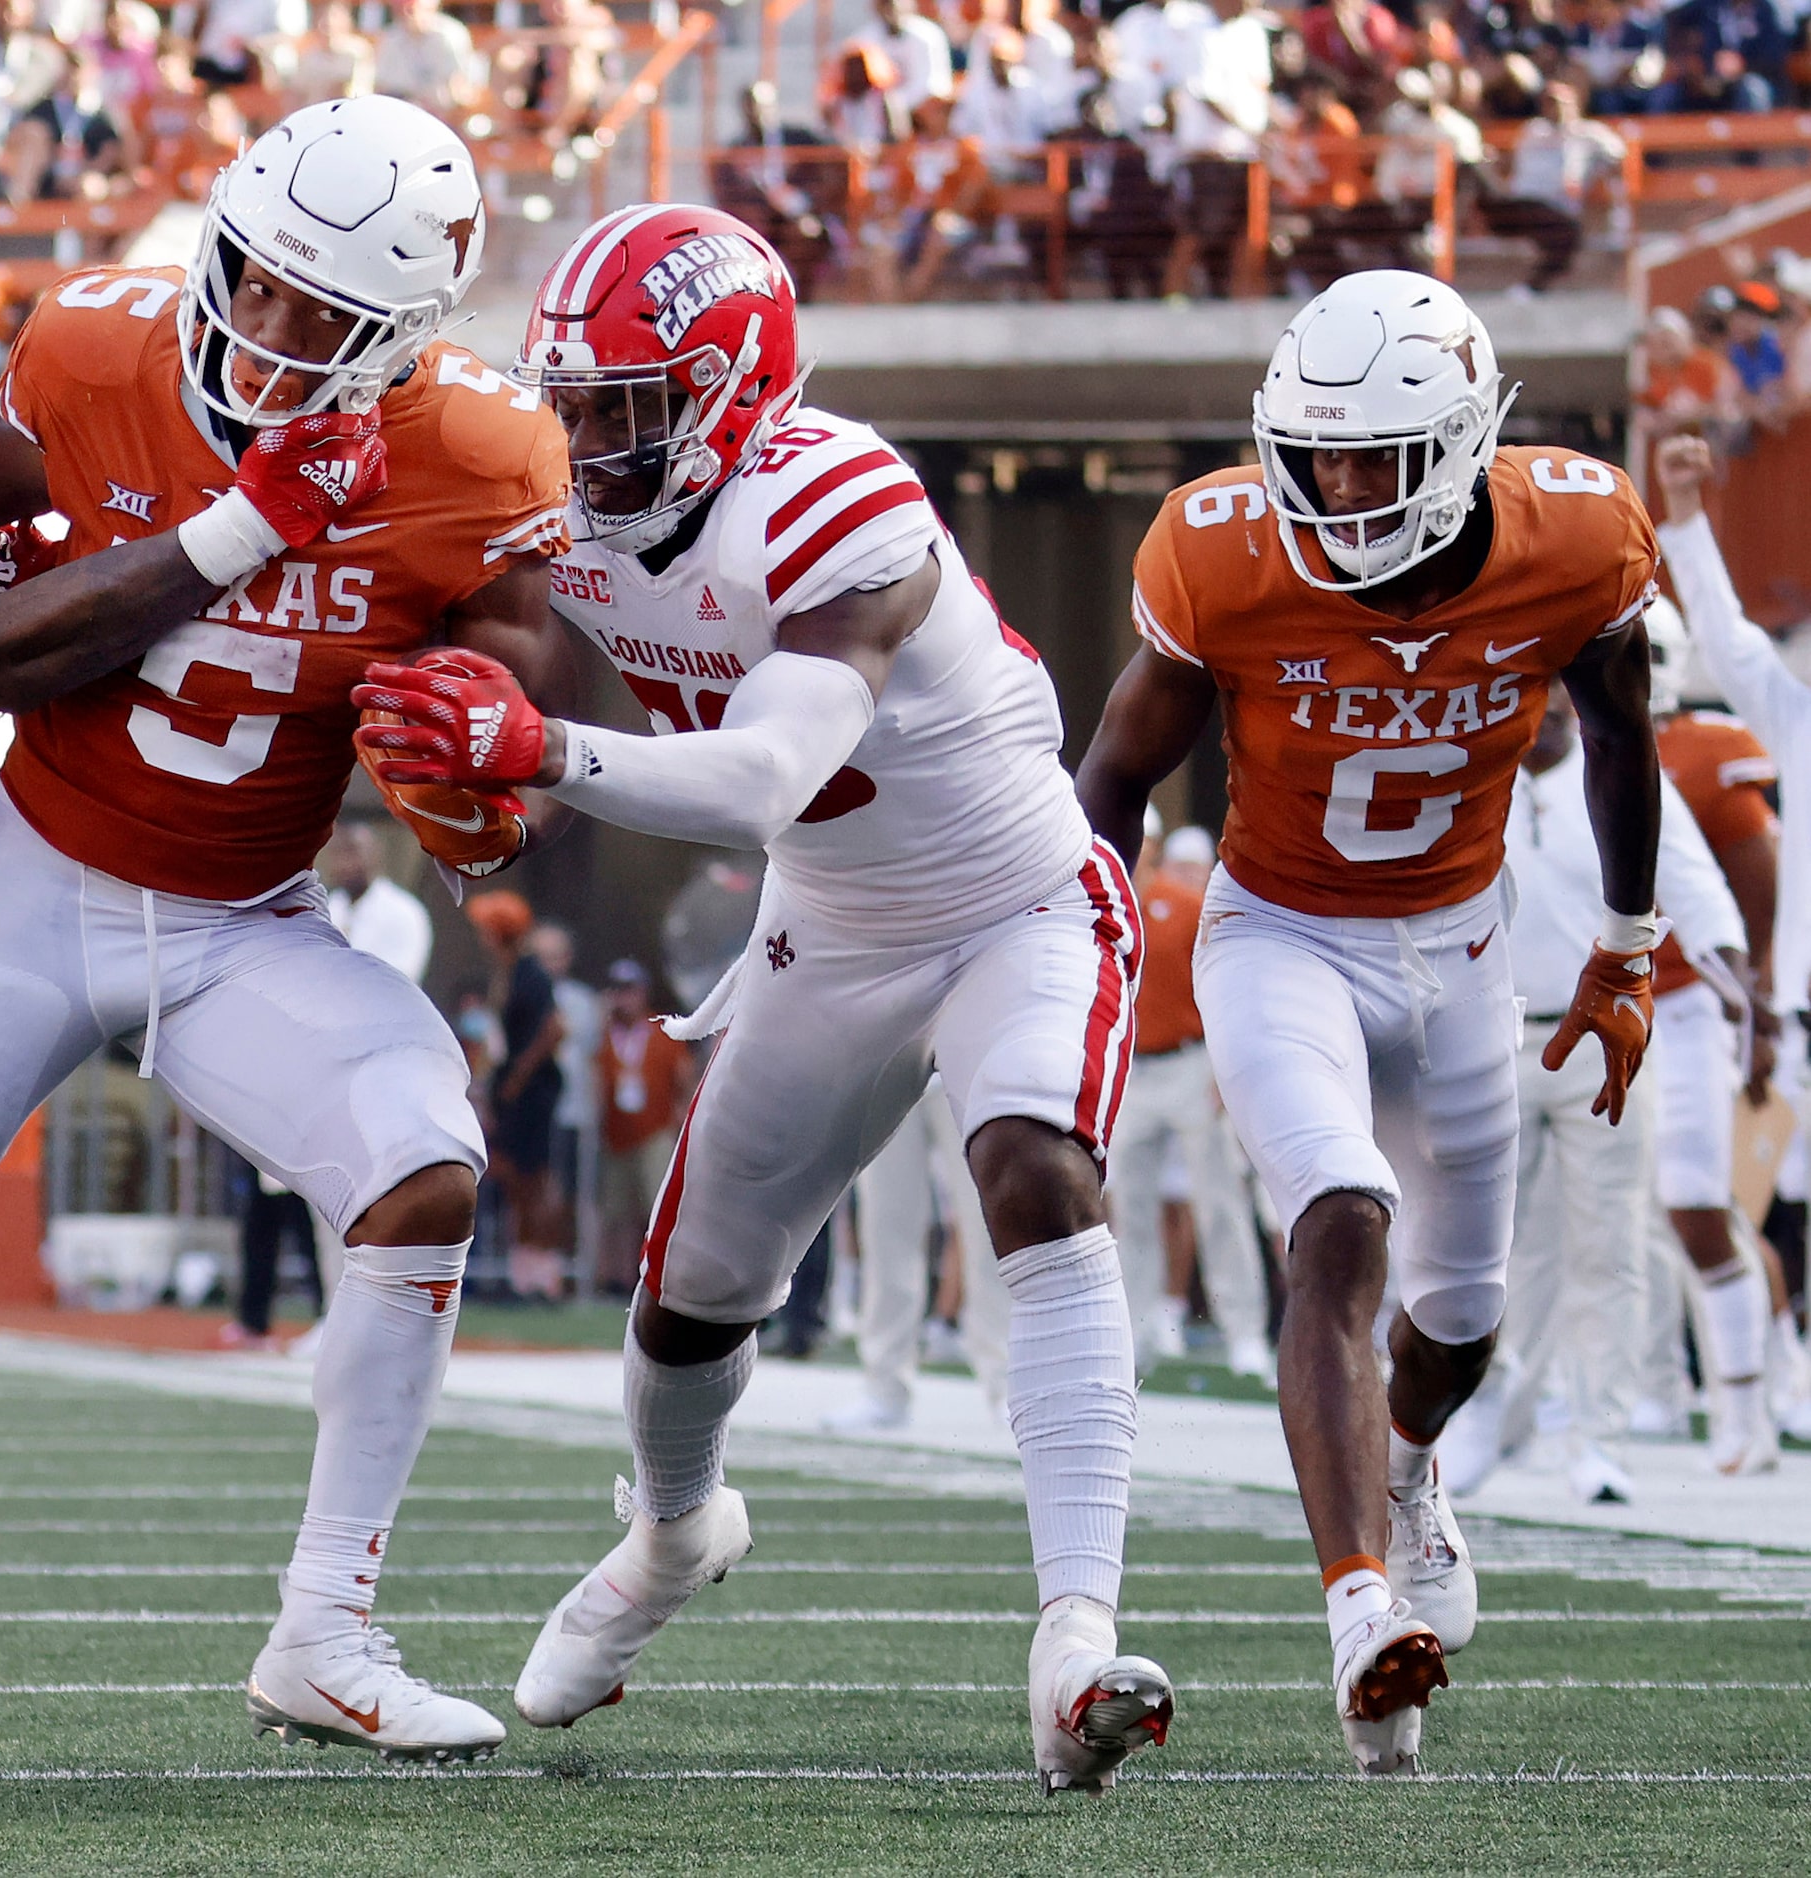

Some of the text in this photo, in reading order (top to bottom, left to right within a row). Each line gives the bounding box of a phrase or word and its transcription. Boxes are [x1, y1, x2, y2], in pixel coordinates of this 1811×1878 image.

[273, 228, 320, 263] HORNS
[56, 274, 180, 320] 5
[436, 352, 541, 413] 5
[1303, 405, 1346, 420] HORNS
[298, 463, 348, 507] adidas
[1530, 456, 1617, 498] 6
[100, 479, 157, 524] XII
[1183, 481, 1268, 529] 6
[187, 560, 376, 635] XAS
[696, 608, 727, 622] adidas
[595, 628, 748, 681] LOUISIANA
[1275, 657, 1330, 685] XII
[126, 618, 304, 786] 5
[1290, 672, 1523, 740] TEXAS
[470, 700, 508, 768] adidas
